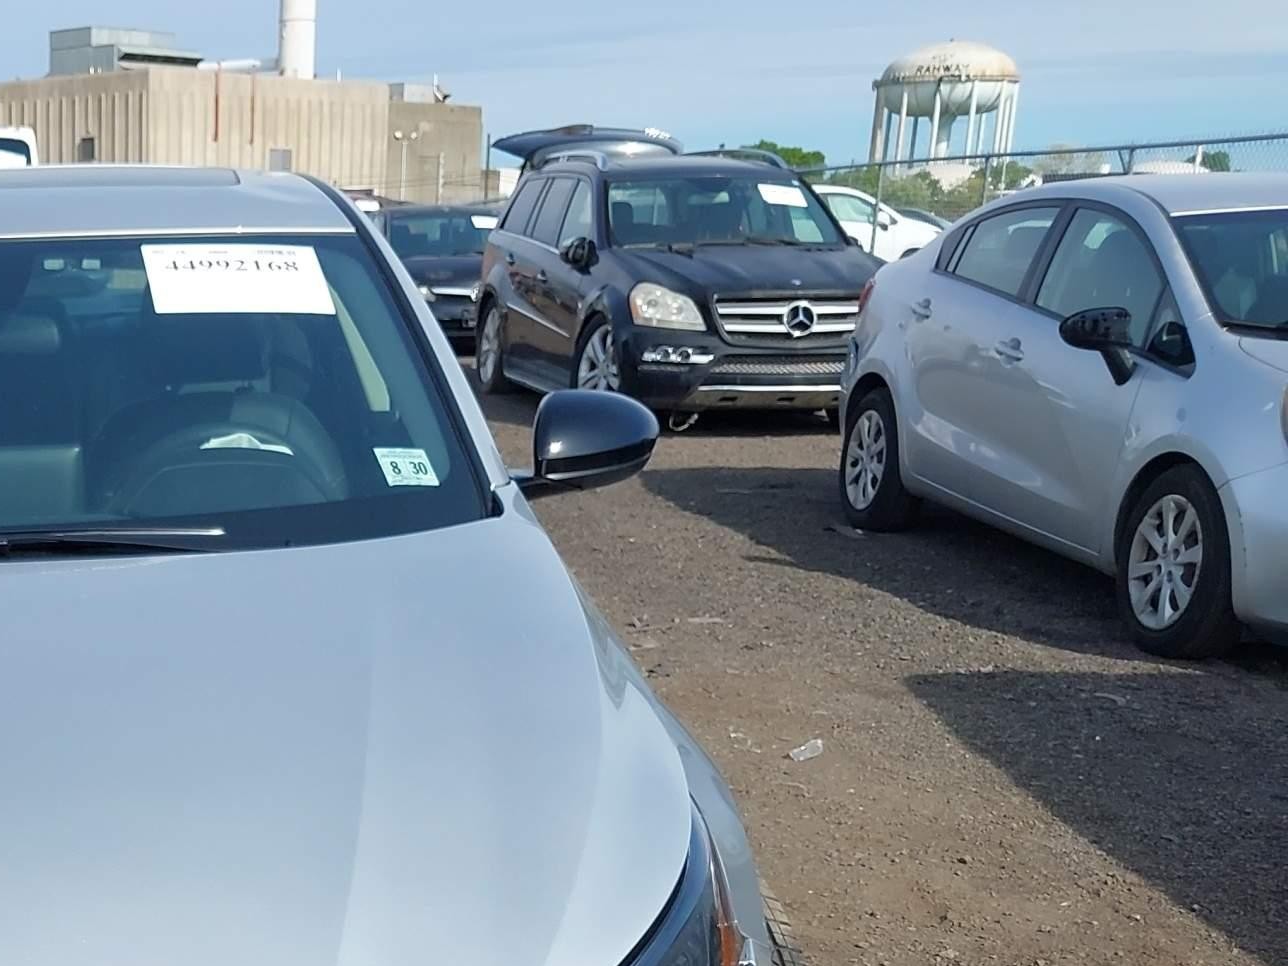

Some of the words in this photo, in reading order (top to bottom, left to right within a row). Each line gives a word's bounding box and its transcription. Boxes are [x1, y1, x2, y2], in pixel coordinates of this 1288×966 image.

[915, 64, 971, 75] RAHWAY
[165, 259, 300, 272] 44992168
[390, 461, 402, 475] 8
[408, 461, 428, 475] 30
